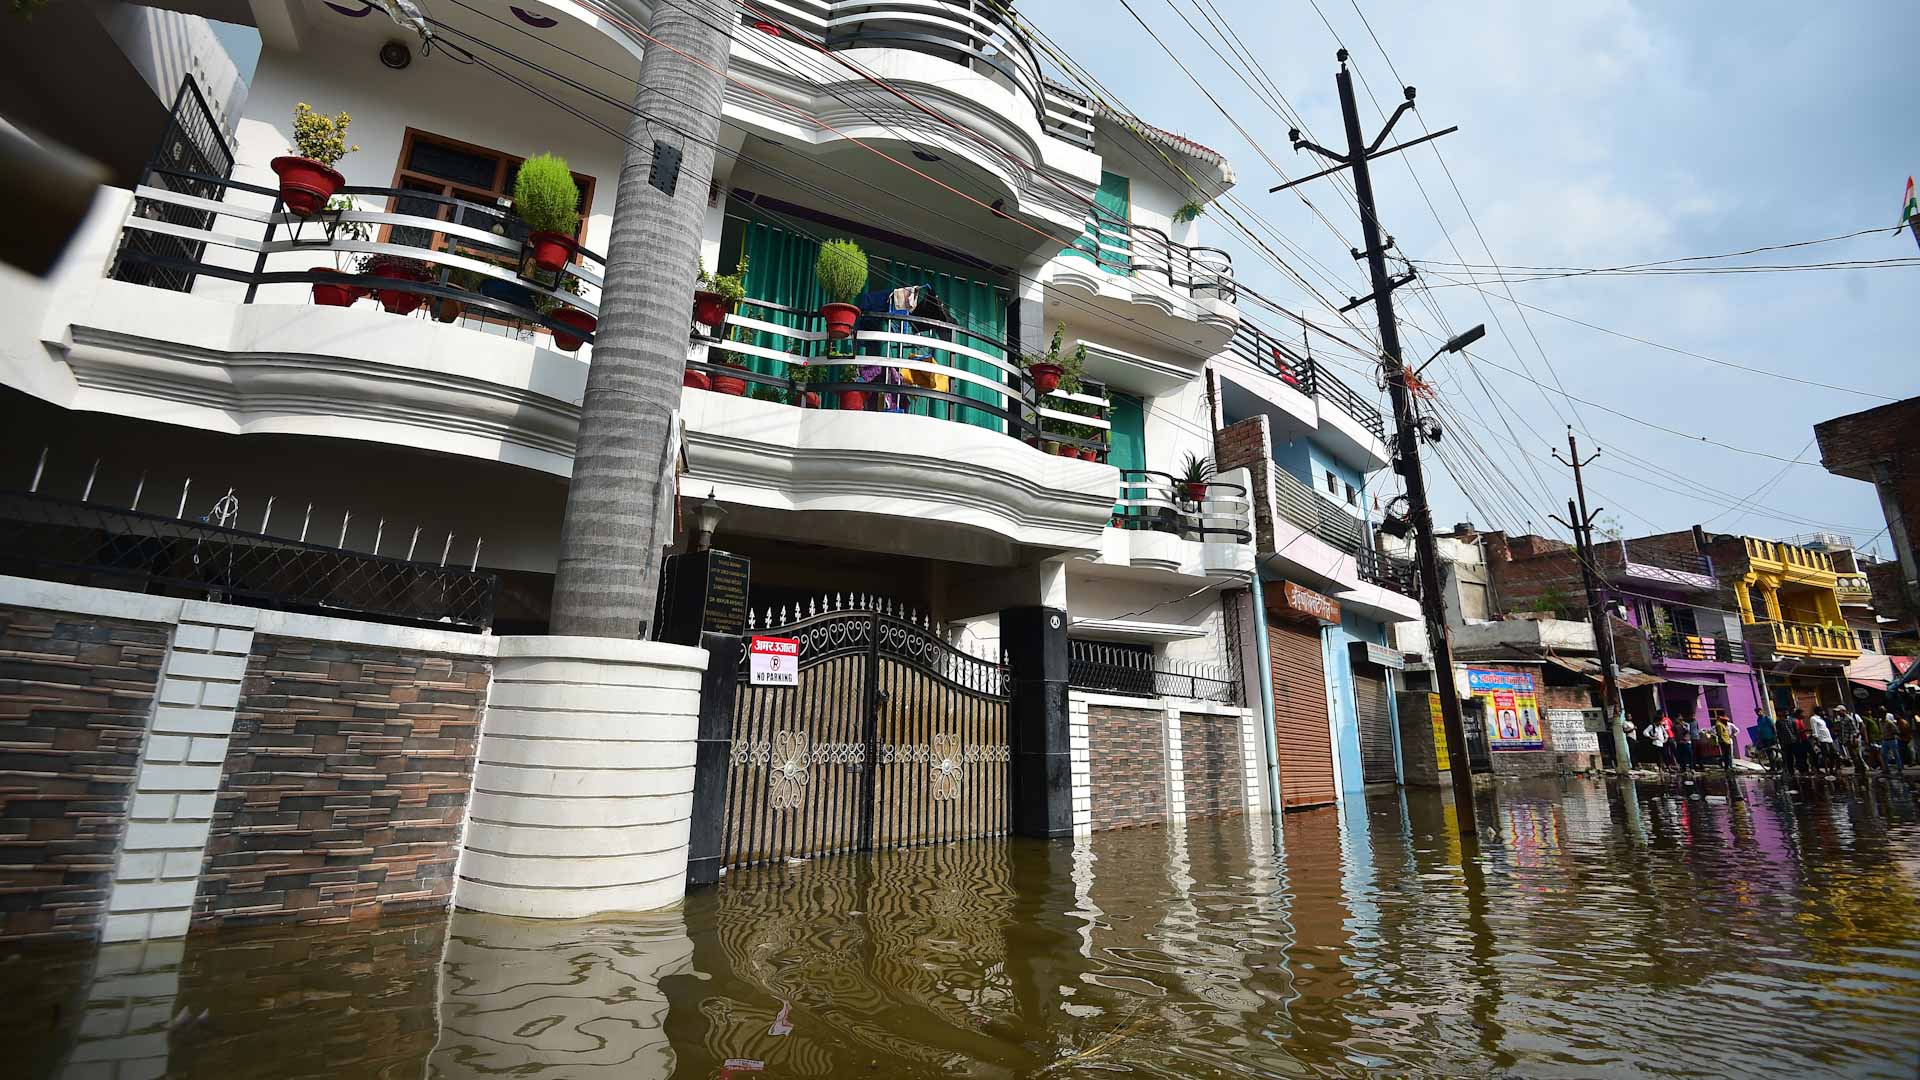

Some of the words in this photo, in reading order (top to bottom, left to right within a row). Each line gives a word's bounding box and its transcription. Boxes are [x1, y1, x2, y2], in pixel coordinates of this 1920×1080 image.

[754, 640, 773, 652] अमर
[773, 642, 797, 653] उजाला
[757, 672, 765, 681] NO
[766, 672, 793, 682] PARKING
